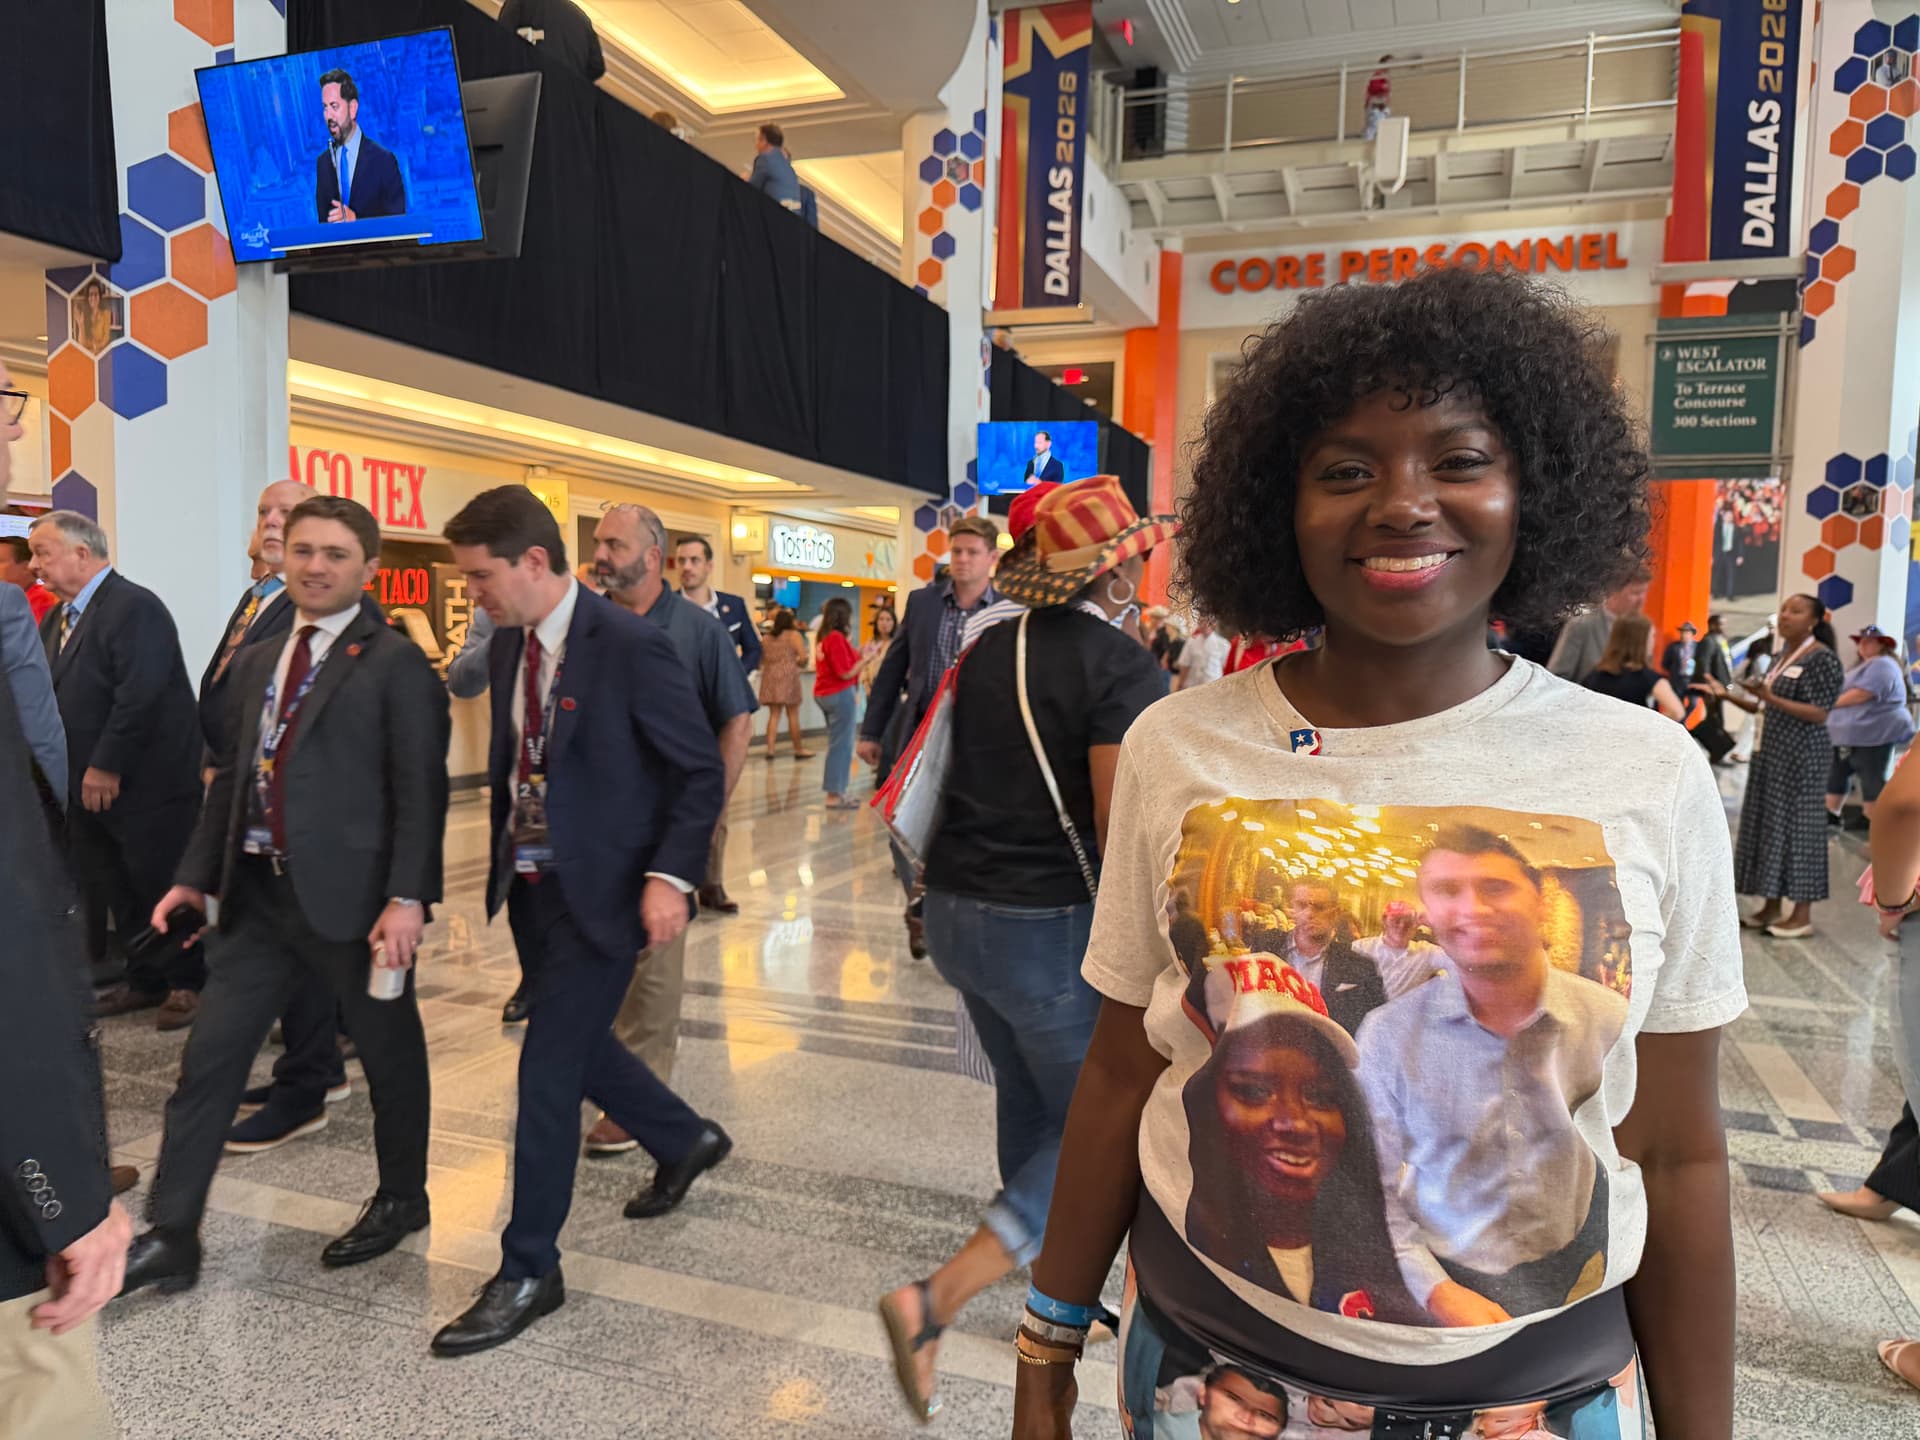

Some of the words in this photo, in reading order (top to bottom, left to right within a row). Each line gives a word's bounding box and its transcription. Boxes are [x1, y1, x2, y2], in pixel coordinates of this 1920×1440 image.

[1056, 71, 1078, 163] 2026
[1741, 99, 1782, 248] DALLAS
[1044, 166, 1074, 297] DALLAS
[1209, 252, 1325, 295] CORE
[1340, 232, 1628, 284] PERSONNEL
[1676, 358, 1766, 373] ESCALATOR
[1677, 347, 1719, 358] WEST
[1673, 396, 1747, 409] Concourse
[1676, 383, 1692, 394] To
[1697, 382, 1746, 394] Terrace
[1672, 415, 1698, 428] 300
[1701, 413, 1758, 428] Sections
[362, 457, 427, 530] TEX
[376, 568, 430, 606] TACO
